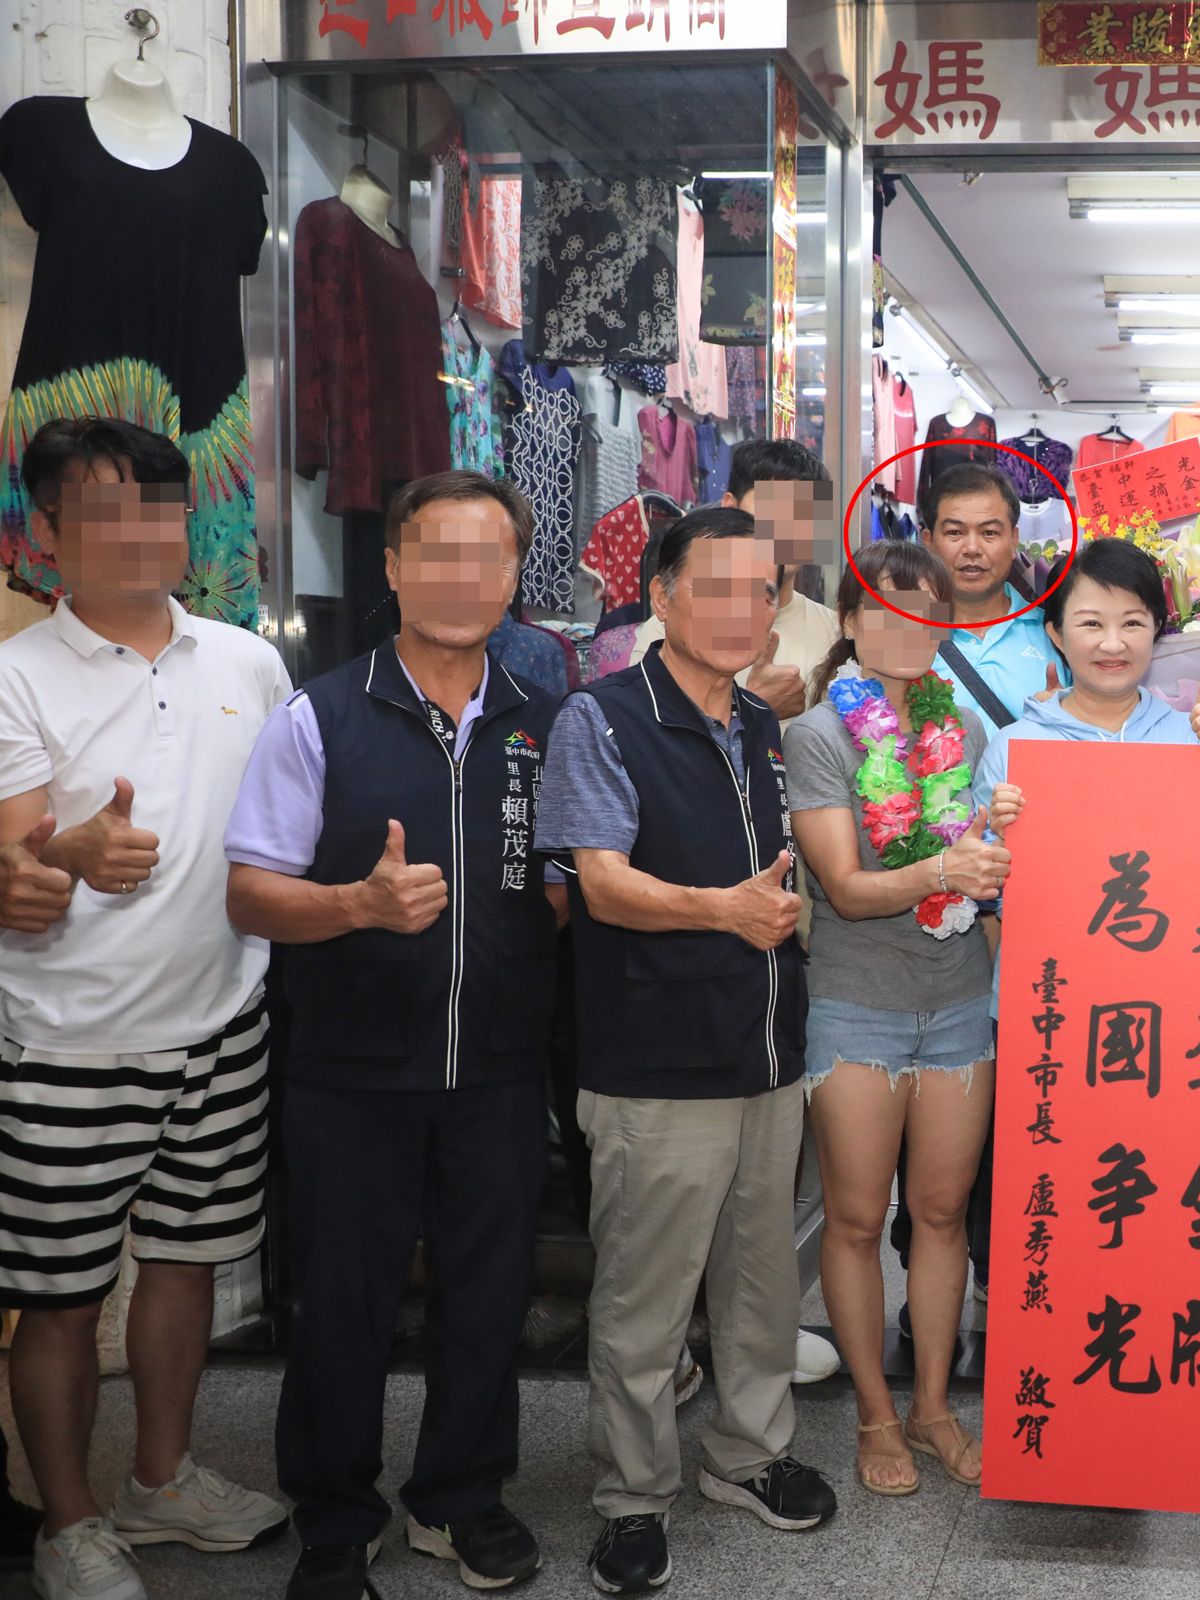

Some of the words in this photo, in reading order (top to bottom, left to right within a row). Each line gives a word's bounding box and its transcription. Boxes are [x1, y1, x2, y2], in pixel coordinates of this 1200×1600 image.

[504, 745, 540, 760] 臺中市政府
[1025, 957, 1068, 1145] 臺中市長
[1020, 1173, 1059, 1315] 盧秀燕
[1012, 1366, 1056, 1459] 敬賀
